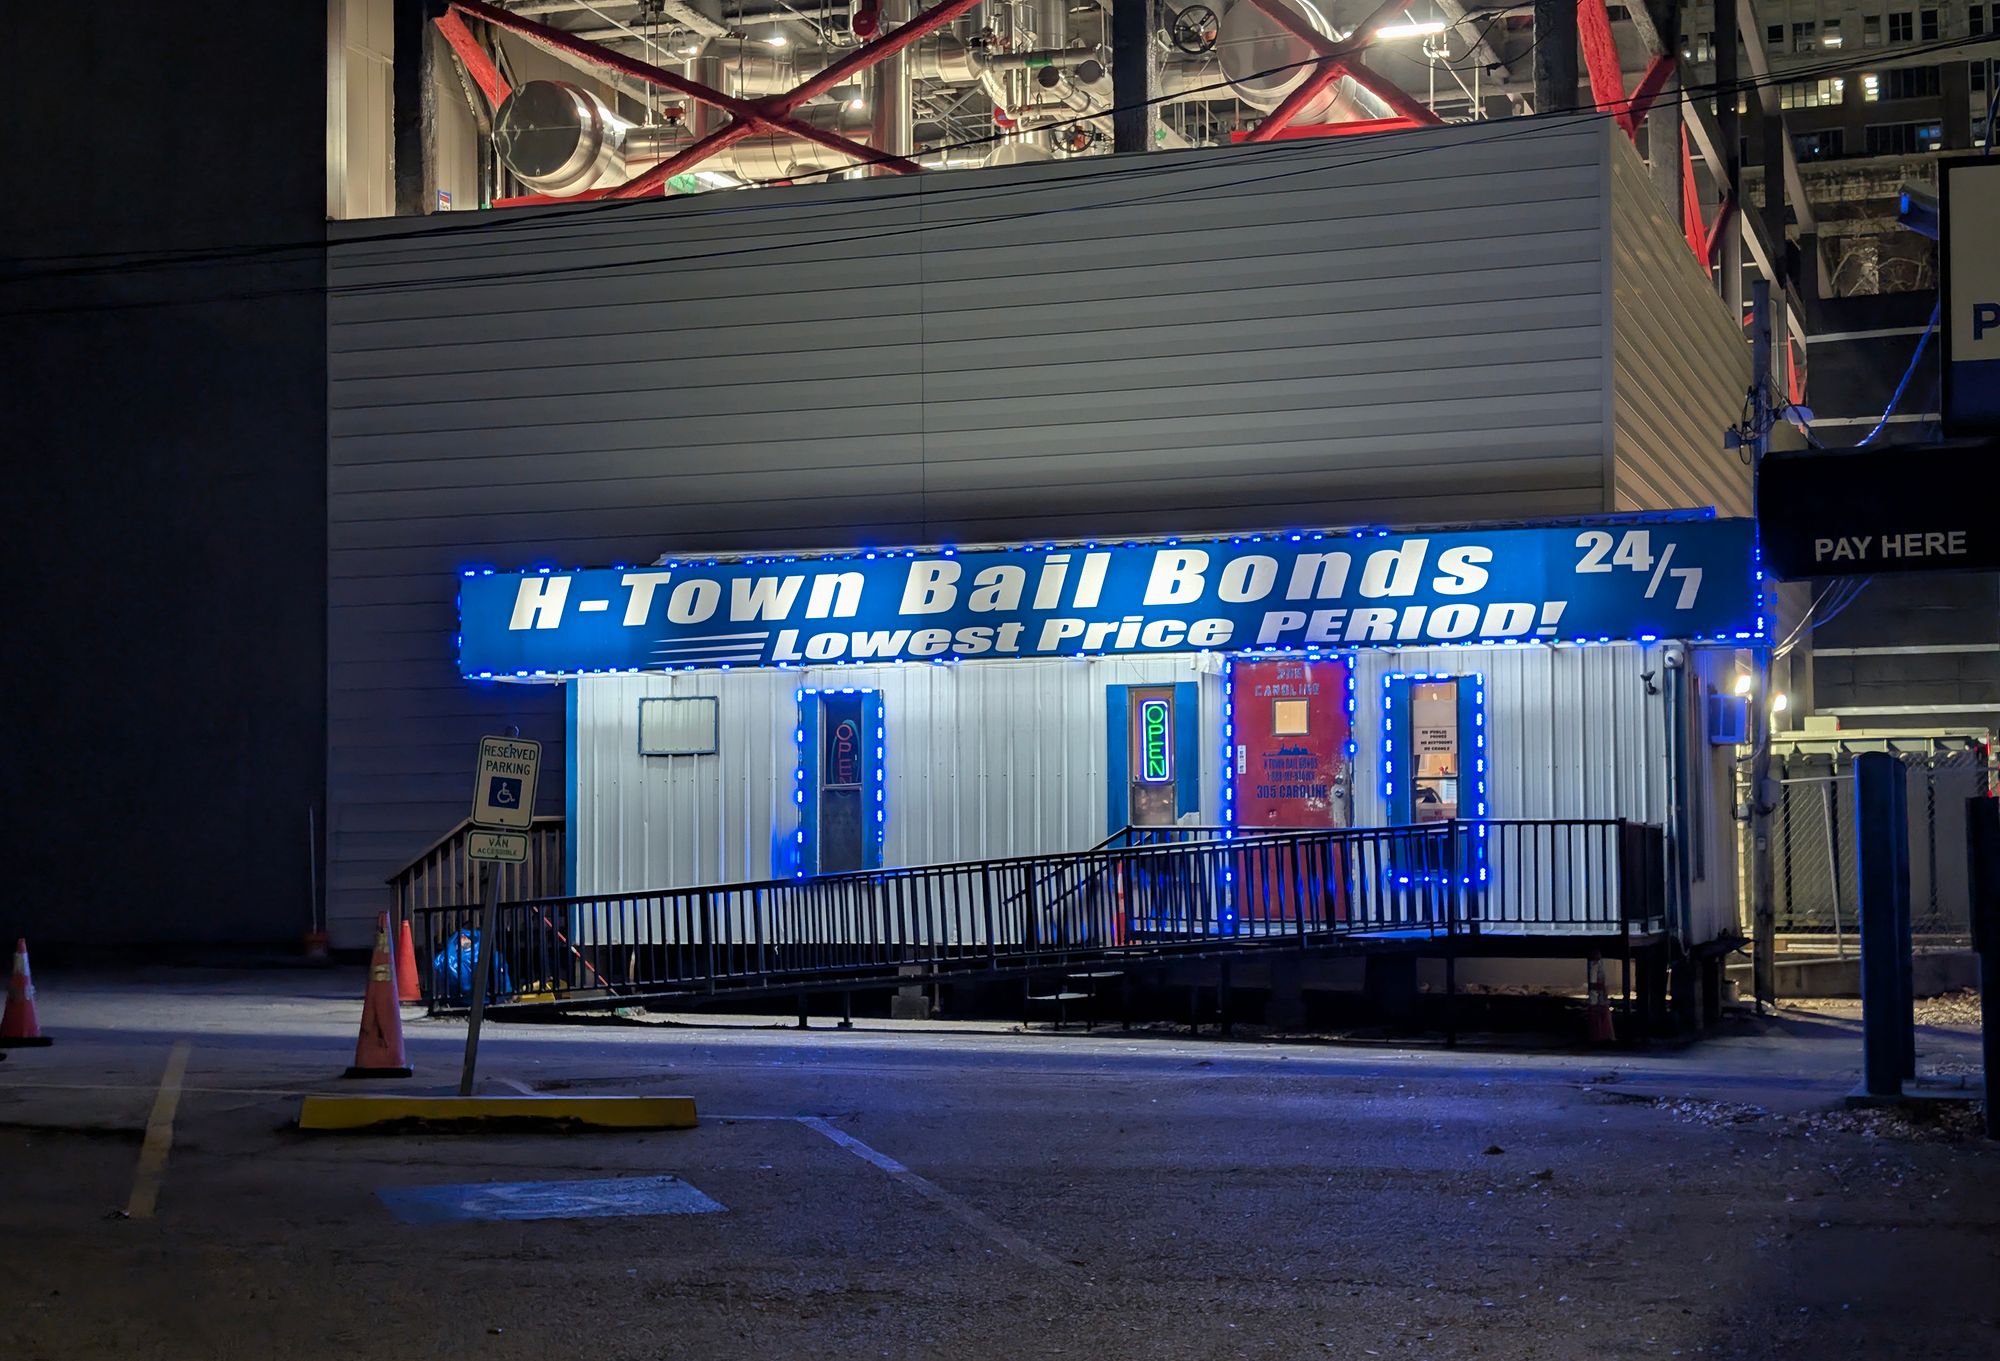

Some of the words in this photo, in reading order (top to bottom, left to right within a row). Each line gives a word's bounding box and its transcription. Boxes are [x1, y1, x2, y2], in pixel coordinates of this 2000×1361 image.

[1815, 535, 1873, 562] PAY
[1881, 530, 1968, 558] HERE
[509, 571, 866, 630] H-Town
[898, 552, 1112, 615] Bail
[1142, 538, 1494, 606] Bonds
[1574, 529, 1703, 610] 24/7
[771, 621, 1025, 661] Lowest
[1036, 615, 1235, 651] Price
[1256, 601, 1568, 644] PERIOD!
[484, 744, 535, 760] RESERVED
[1146, 705, 1165, 777] OPEN
[486, 760, 530, 775] PARKING
[1256, 785, 1277, 799] 305
[1279, 784, 1328, 799] CAROLINE
[488, 837, 509, 848] VAN
